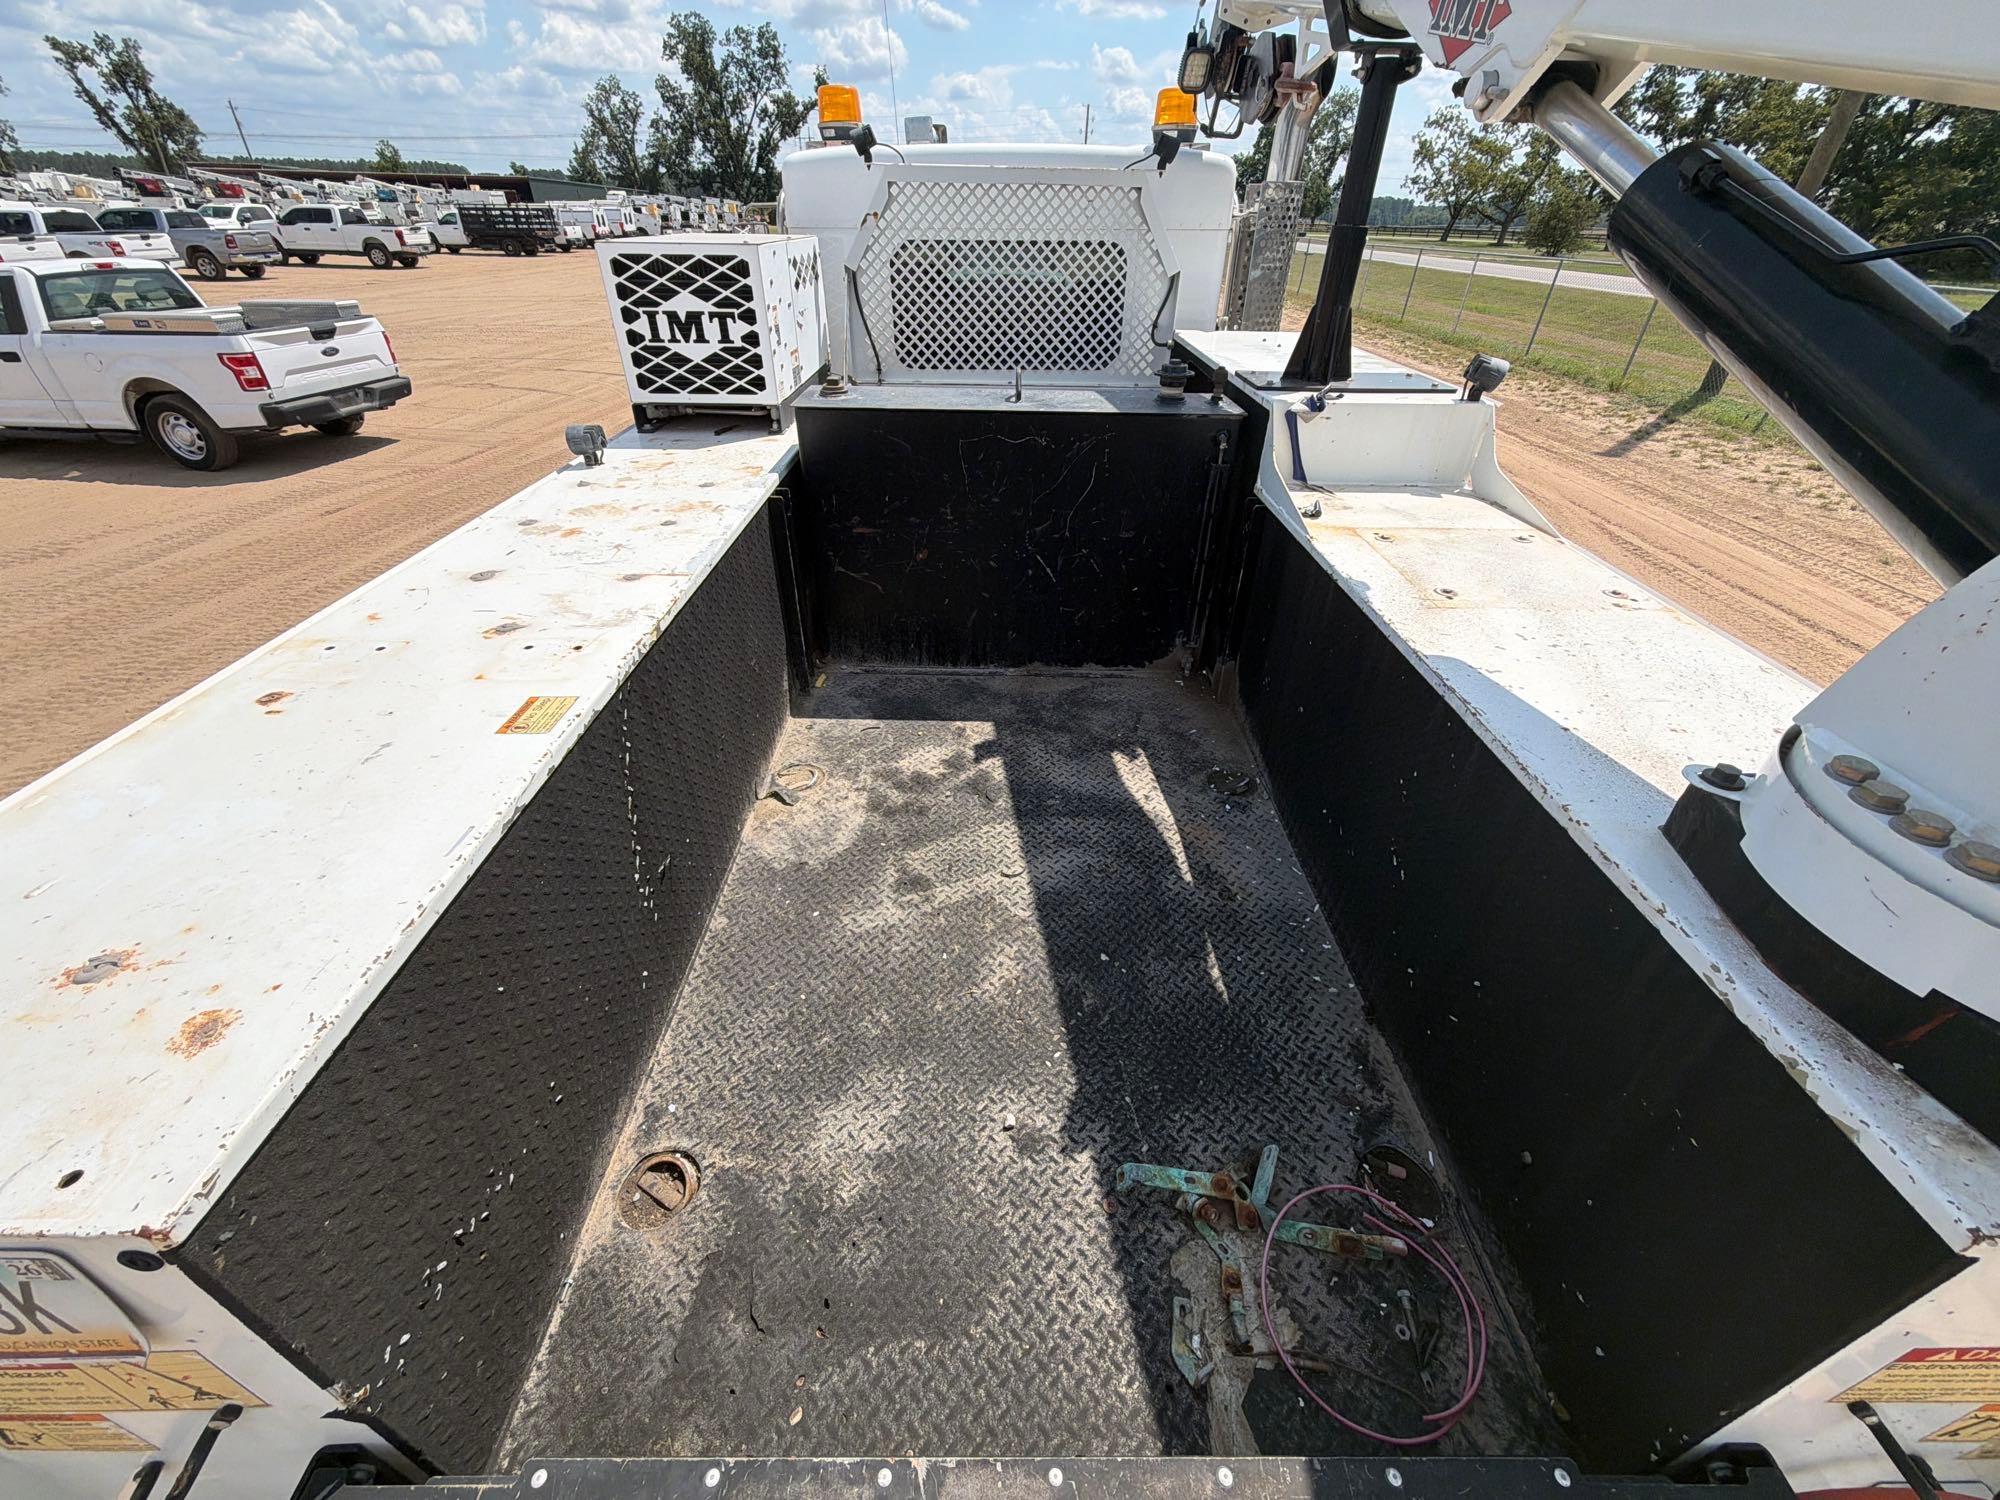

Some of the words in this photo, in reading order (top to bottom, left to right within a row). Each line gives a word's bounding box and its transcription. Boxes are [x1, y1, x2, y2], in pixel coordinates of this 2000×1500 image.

[1428, 0, 1506, 44] IMT
[641, 310, 737, 345] IMT
[7, 1264, 43, 1276] 26
[79, 1339, 122, 1348] STATE
